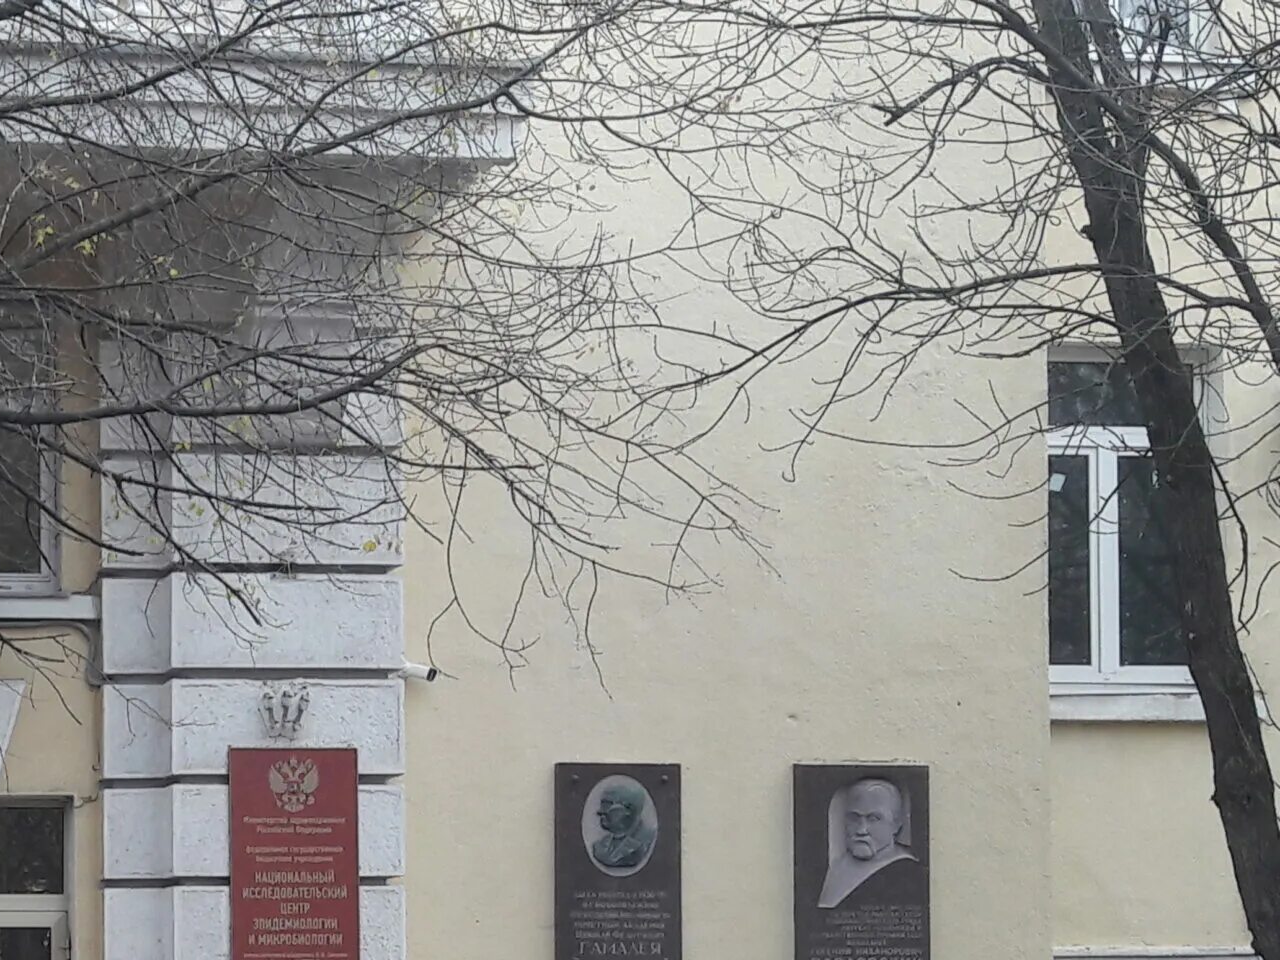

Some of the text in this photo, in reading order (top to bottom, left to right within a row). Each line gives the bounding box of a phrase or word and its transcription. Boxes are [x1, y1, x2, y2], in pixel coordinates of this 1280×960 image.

[255, 869, 335, 884] НАЦИОНАЛЬНЫЙ
[242, 885, 348, 899] ИССЛЕДОВАТЕЛЬСКИЙ
[280, 902, 310, 915] ЦЕНТР
[253, 918, 338, 931] ЭПИДЕМИОЛОГИИ
[248, 934, 343, 946] И МИКРОБИОЛОГИИ
[580, 941, 662, 955] ГАМАЛЕЯ
